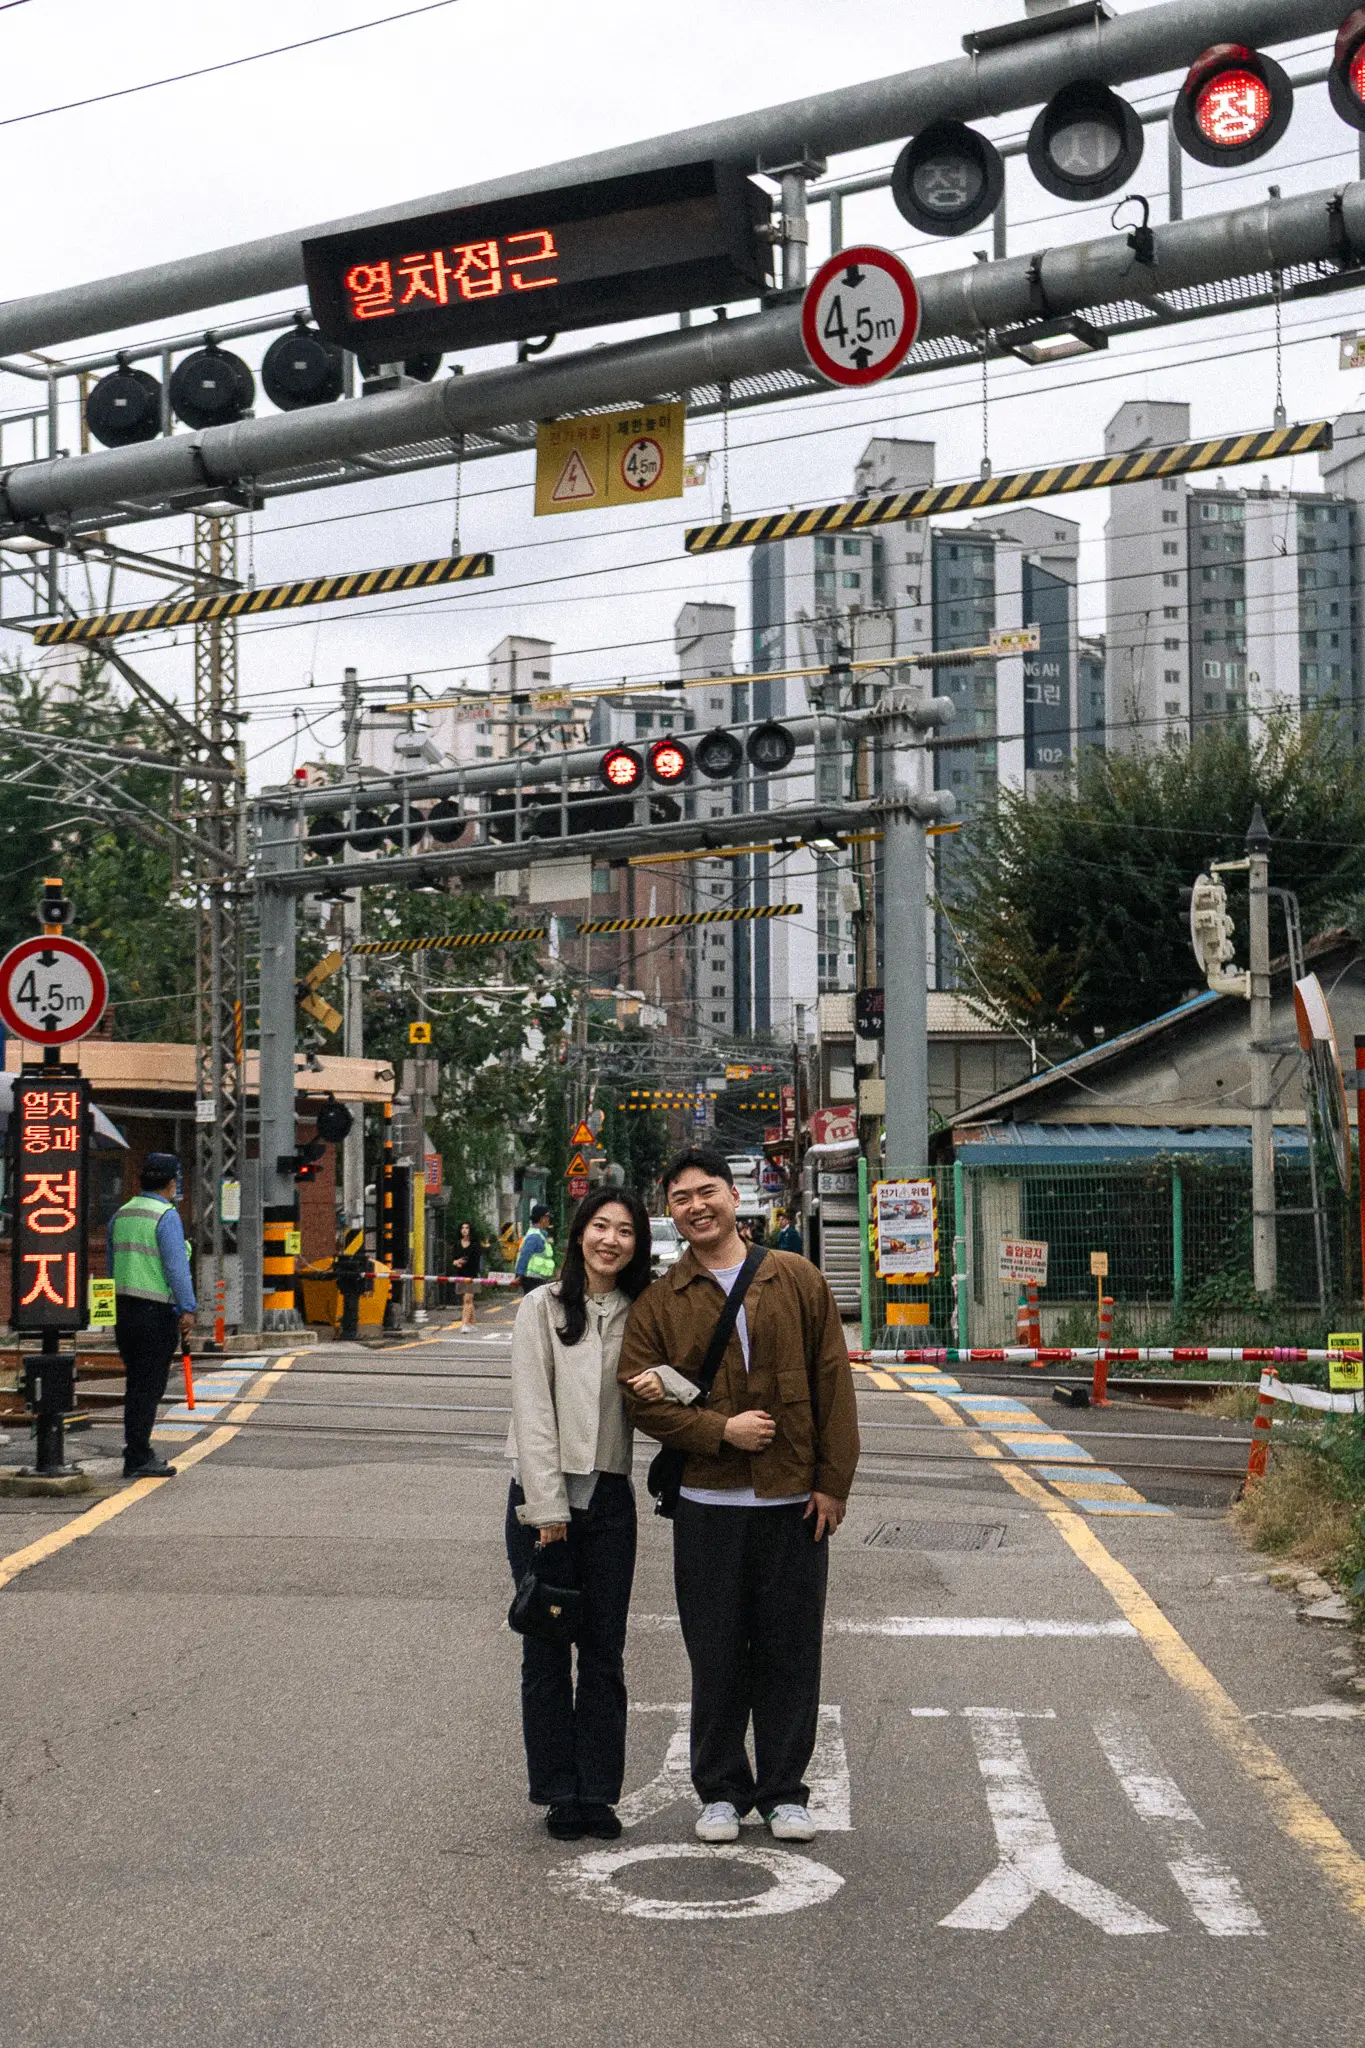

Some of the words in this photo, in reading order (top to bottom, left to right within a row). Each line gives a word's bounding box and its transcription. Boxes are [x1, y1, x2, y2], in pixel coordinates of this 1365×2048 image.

[1210, 91, 1256, 138] 정
[346, 230, 558, 319] 열차접근
[823, 294, 897, 349] 4.5m
[1026, 683, 1061, 706] 그린
[1035, 748, 1063, 763] 102
[17, 969, 86, 1013] 4.5m
[22, 1091, 80, 1120] 열차
[23, 1124, 80, 1154] 통과
[879, 1188, 898, 1199] 전기
[911, 1187, 929, 1198] 위험
[1005, 1244, 1043, 1260] 출입금지
